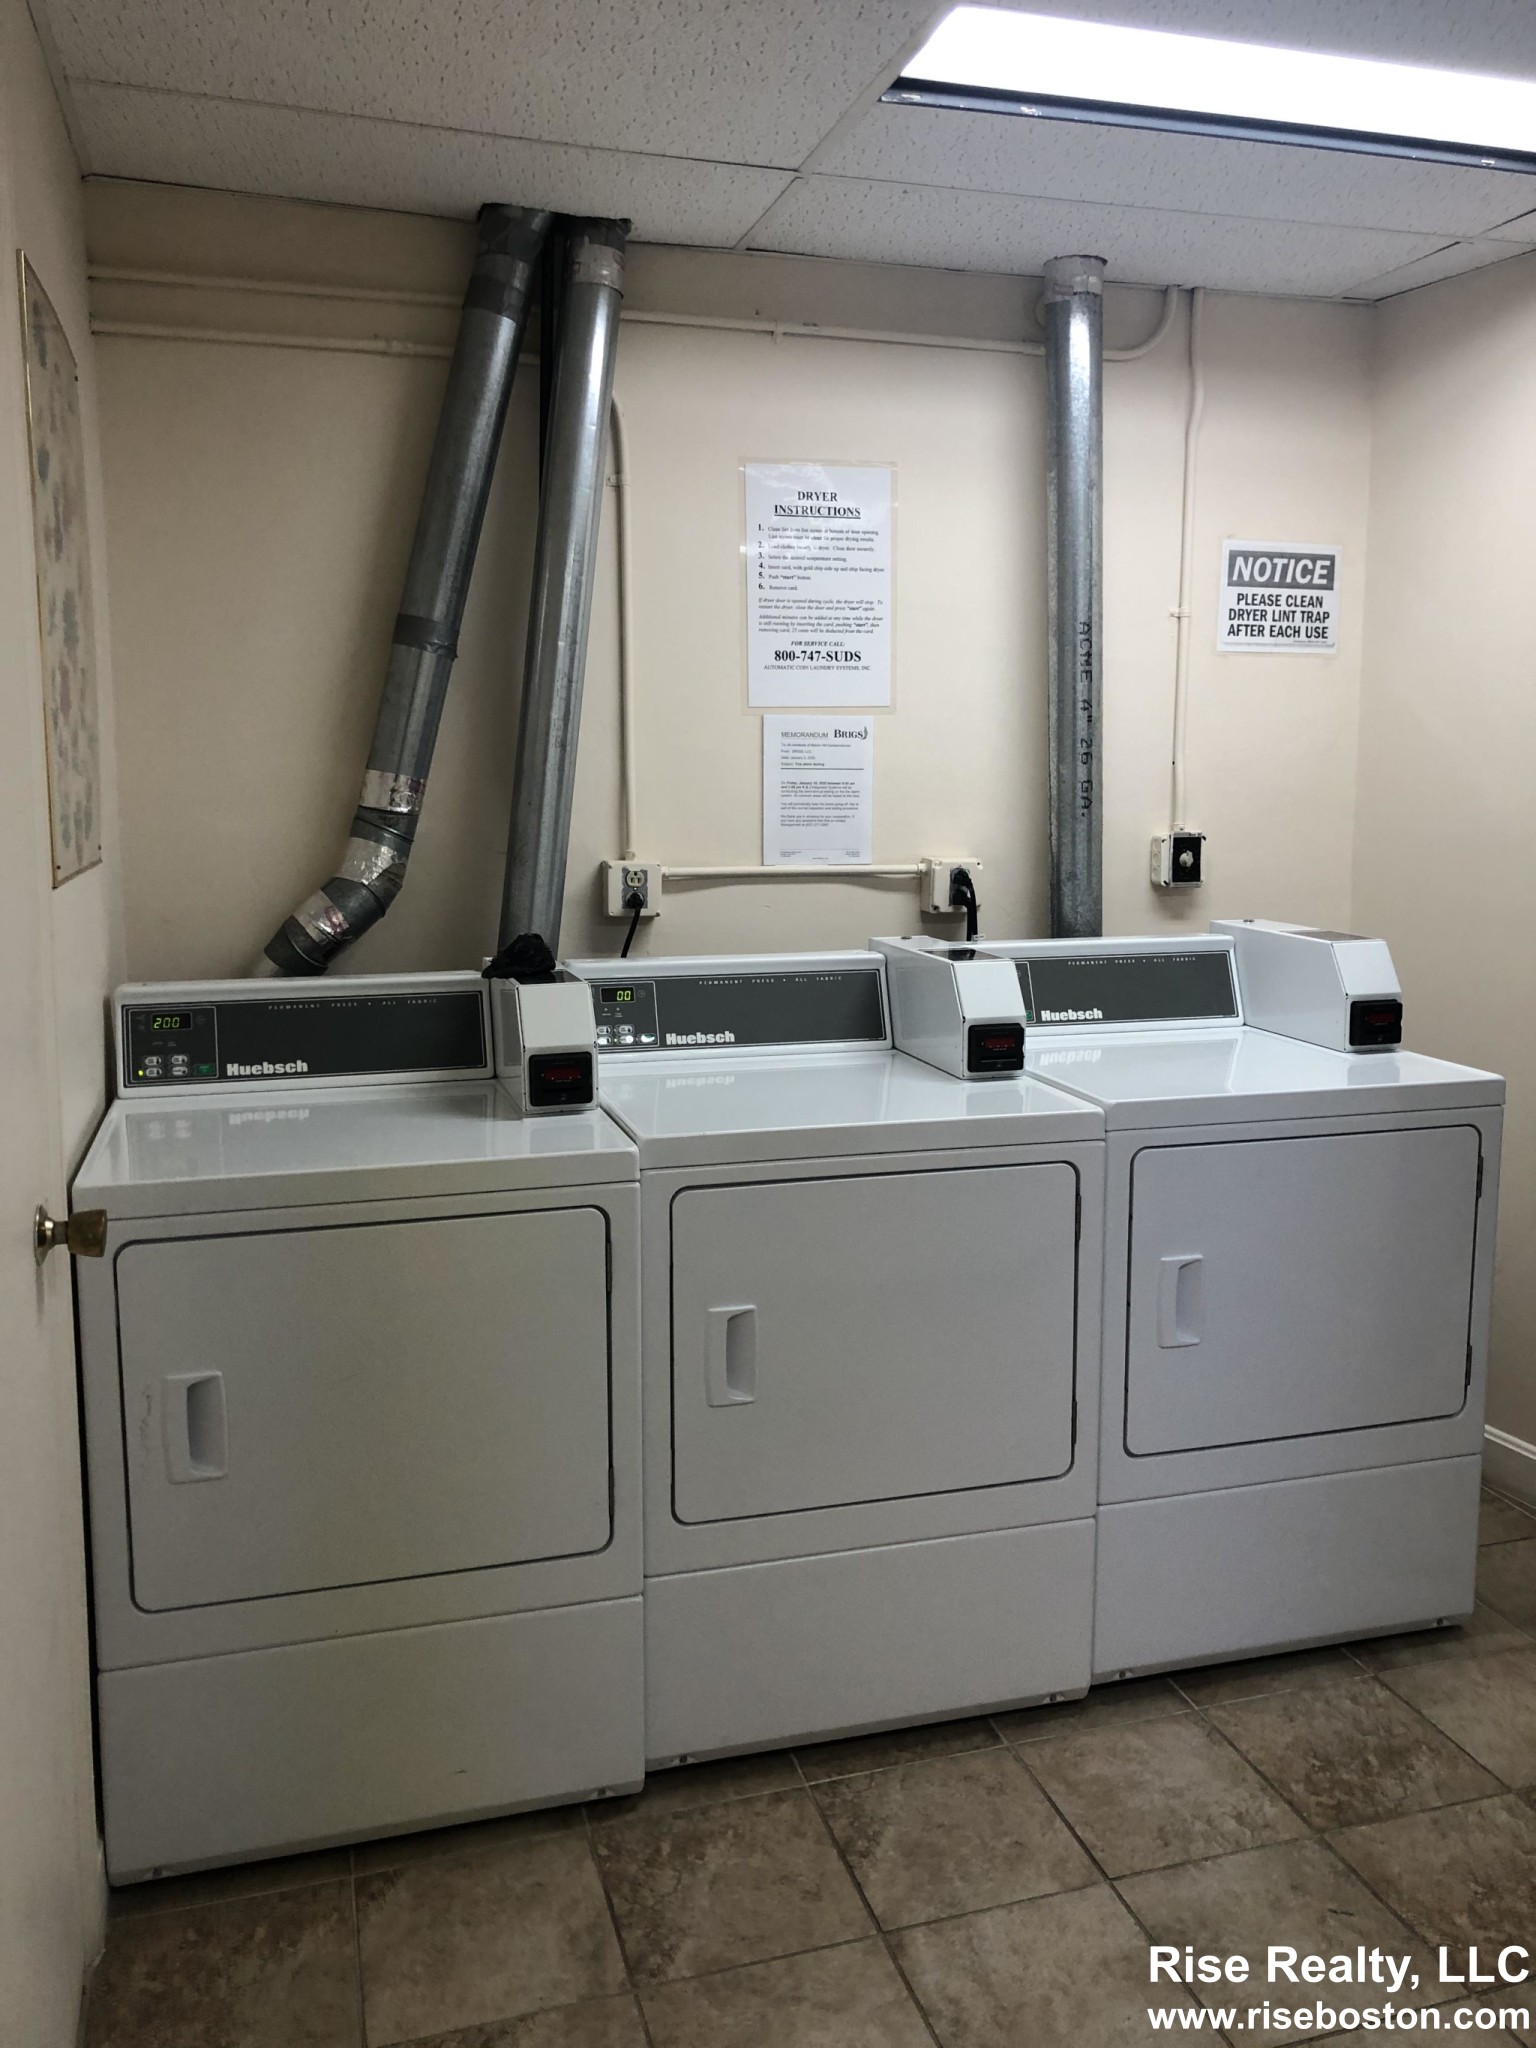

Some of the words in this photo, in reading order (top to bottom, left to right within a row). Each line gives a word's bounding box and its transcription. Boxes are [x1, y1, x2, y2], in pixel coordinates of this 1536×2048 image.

[797, 491, 838, 502] DRYER
[774, 504, 861, 518] INSTRUCTIONS
[1232, 556, 1331, 584] NOTICE
[1237, 593, 1282, 607] PLEASE
[1285, 595, 1323, 608] CLEAN
[1229, 608, 1267, 622] DRYER
[1272, 610, 1296, 622] LINT
[1300, 610, 1330, 624] TRAP
[1227, 624, 1265, 637] AFTER
[1269, 625, 1301, 638] EACH
[1305, 626, 1328, 639] USE
[774, 650, 862, 662] 800-747-SUDS
[1079, 622, 1092, 683] ACME
[1080, 738, 1093, 765] 26
[617, 990, 631, 1000] 00
[1041, 1008, 1103, 1021] Huebsch
[154, 1017, 180, 1029] 200
[666, 1031, 735, 1045] Huebsch
[226, 1060, 308, 1076] Huebsch
